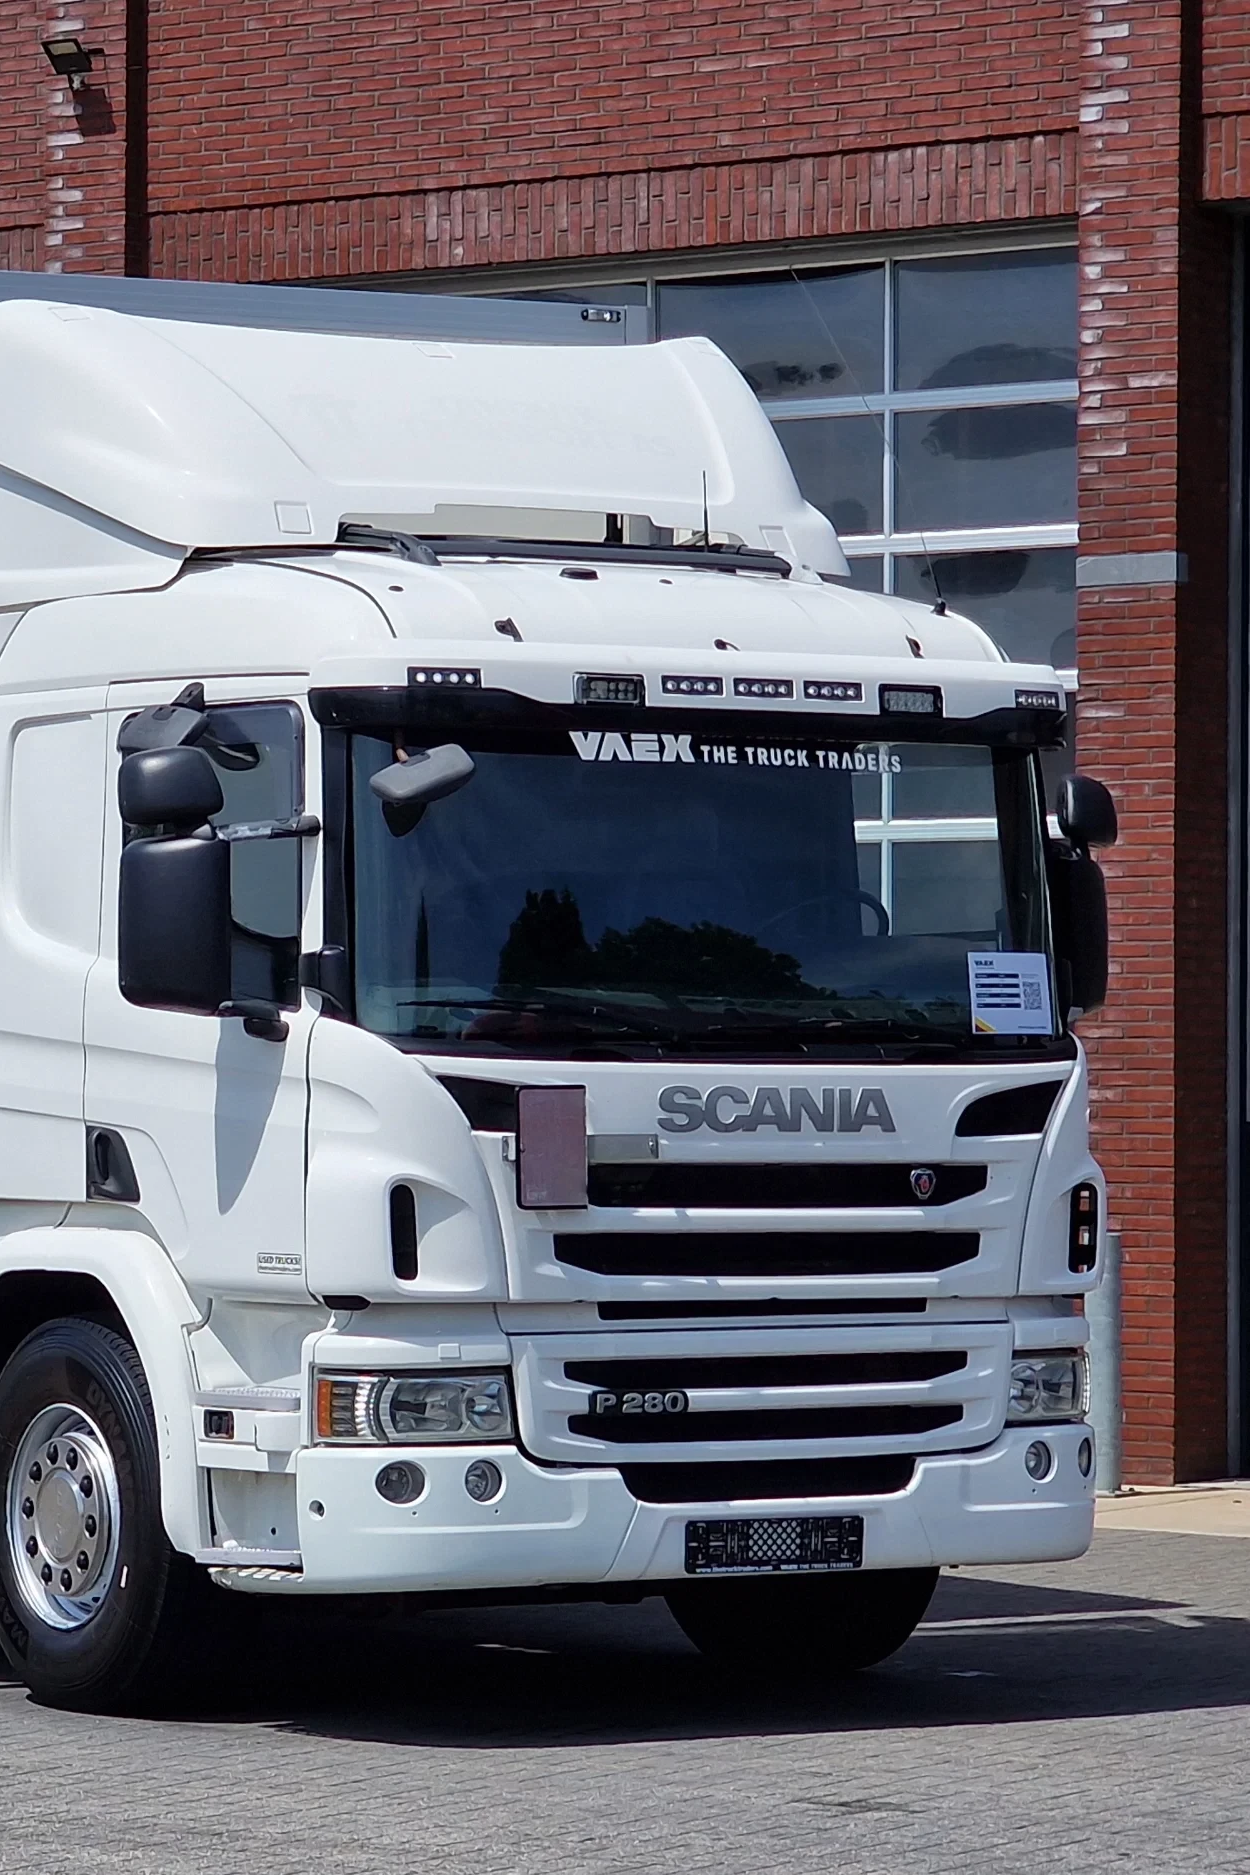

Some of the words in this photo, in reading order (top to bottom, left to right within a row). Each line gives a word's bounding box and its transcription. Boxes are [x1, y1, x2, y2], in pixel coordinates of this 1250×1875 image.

[568, 731, 696, 763] VAEX
[700, 745, 738, 764] THE
[744, 746, 810, 767] TRUCK
[815, 750, 902, 773] TRADERS
[656, 1084, 897, 1133] SCANIA
[596, 1393, 617, 1414] P
[622, 1391, 685, 1414] 280
